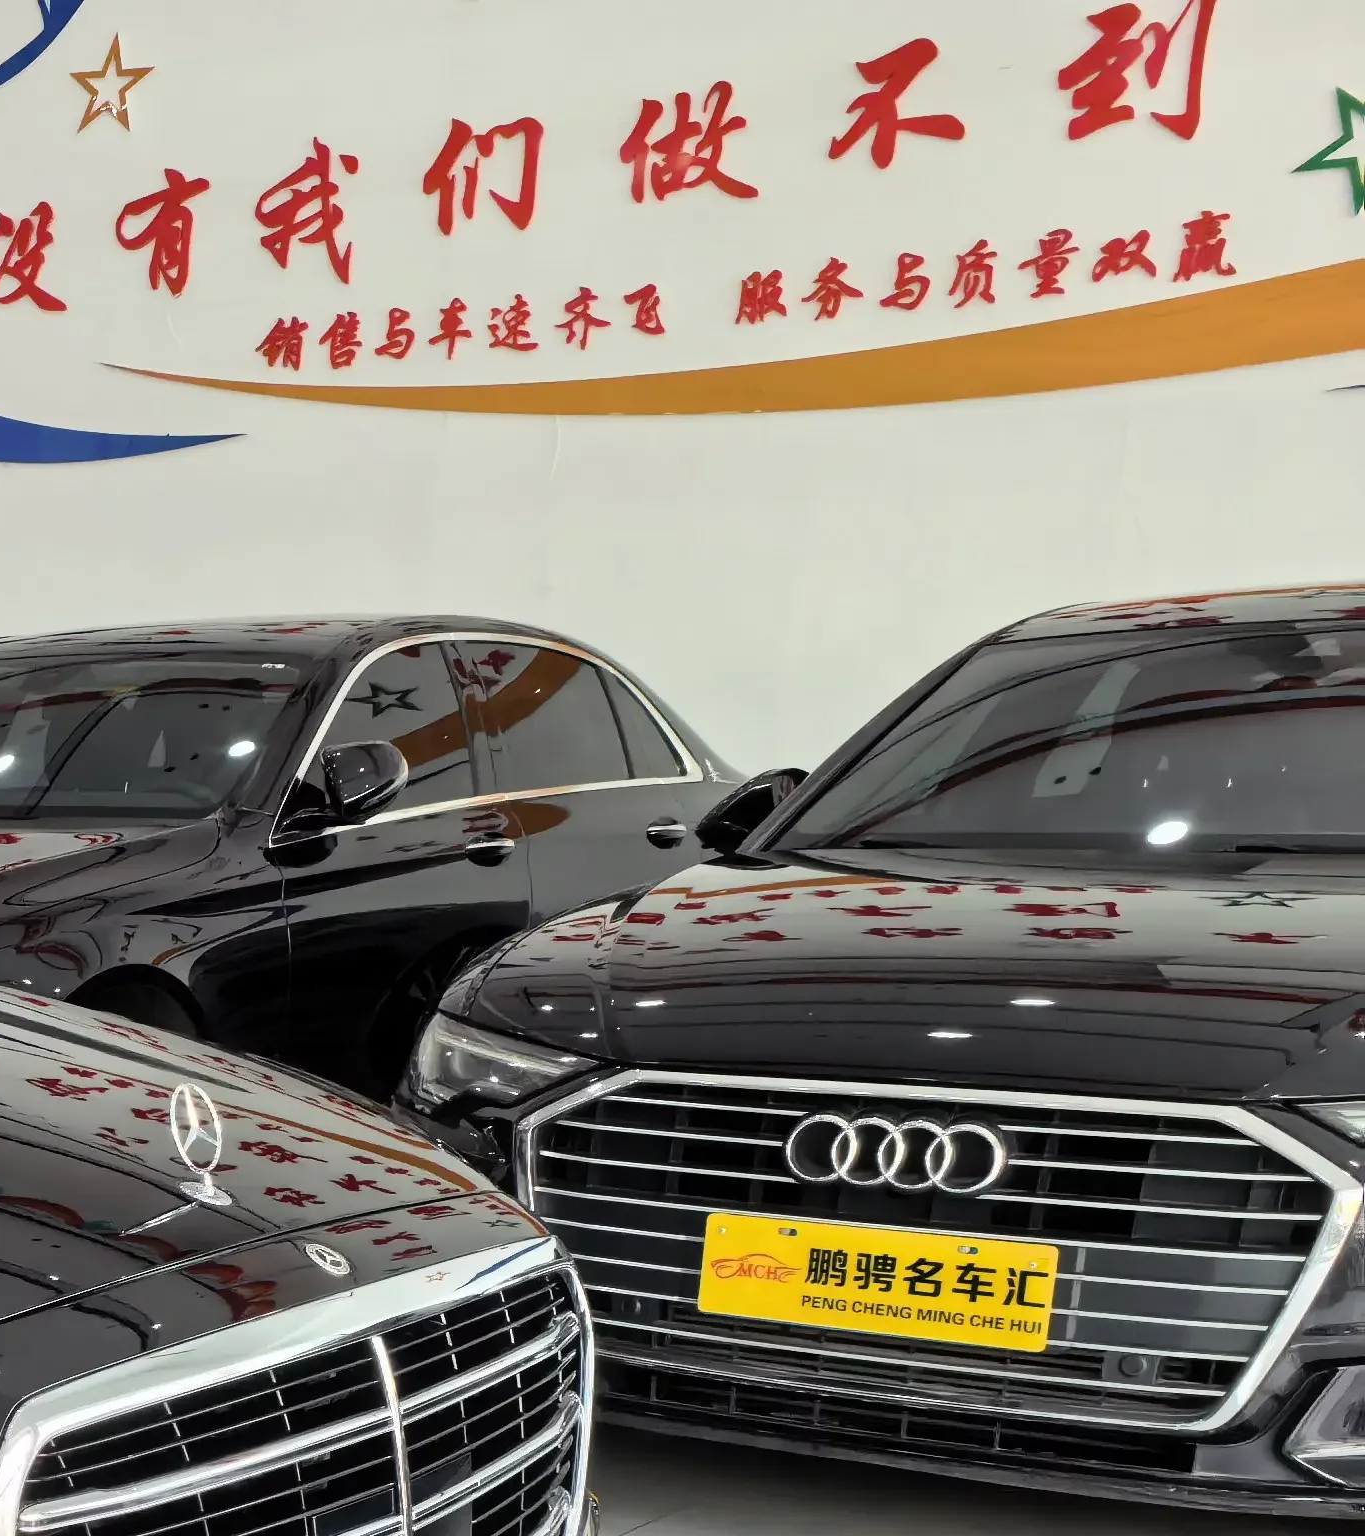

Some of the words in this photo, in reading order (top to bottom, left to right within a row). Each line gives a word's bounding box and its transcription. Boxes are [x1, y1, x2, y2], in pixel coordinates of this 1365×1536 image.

[259, 287, 667, 371] 销售与车速齐飞
[735, 211, 1237, 325] 服务与质量双赢
[803, 1247, 1050, 1309] 鹏骋名车汇
[801, 1295, 847, 1312] PENG
[851, 1301, 912, 1320] CHENG
[916, 1309, 965, 1326] MING
[969, 1314, 1005, 1330] CHE
[1010, 1320, 1042, 1335] HUI
